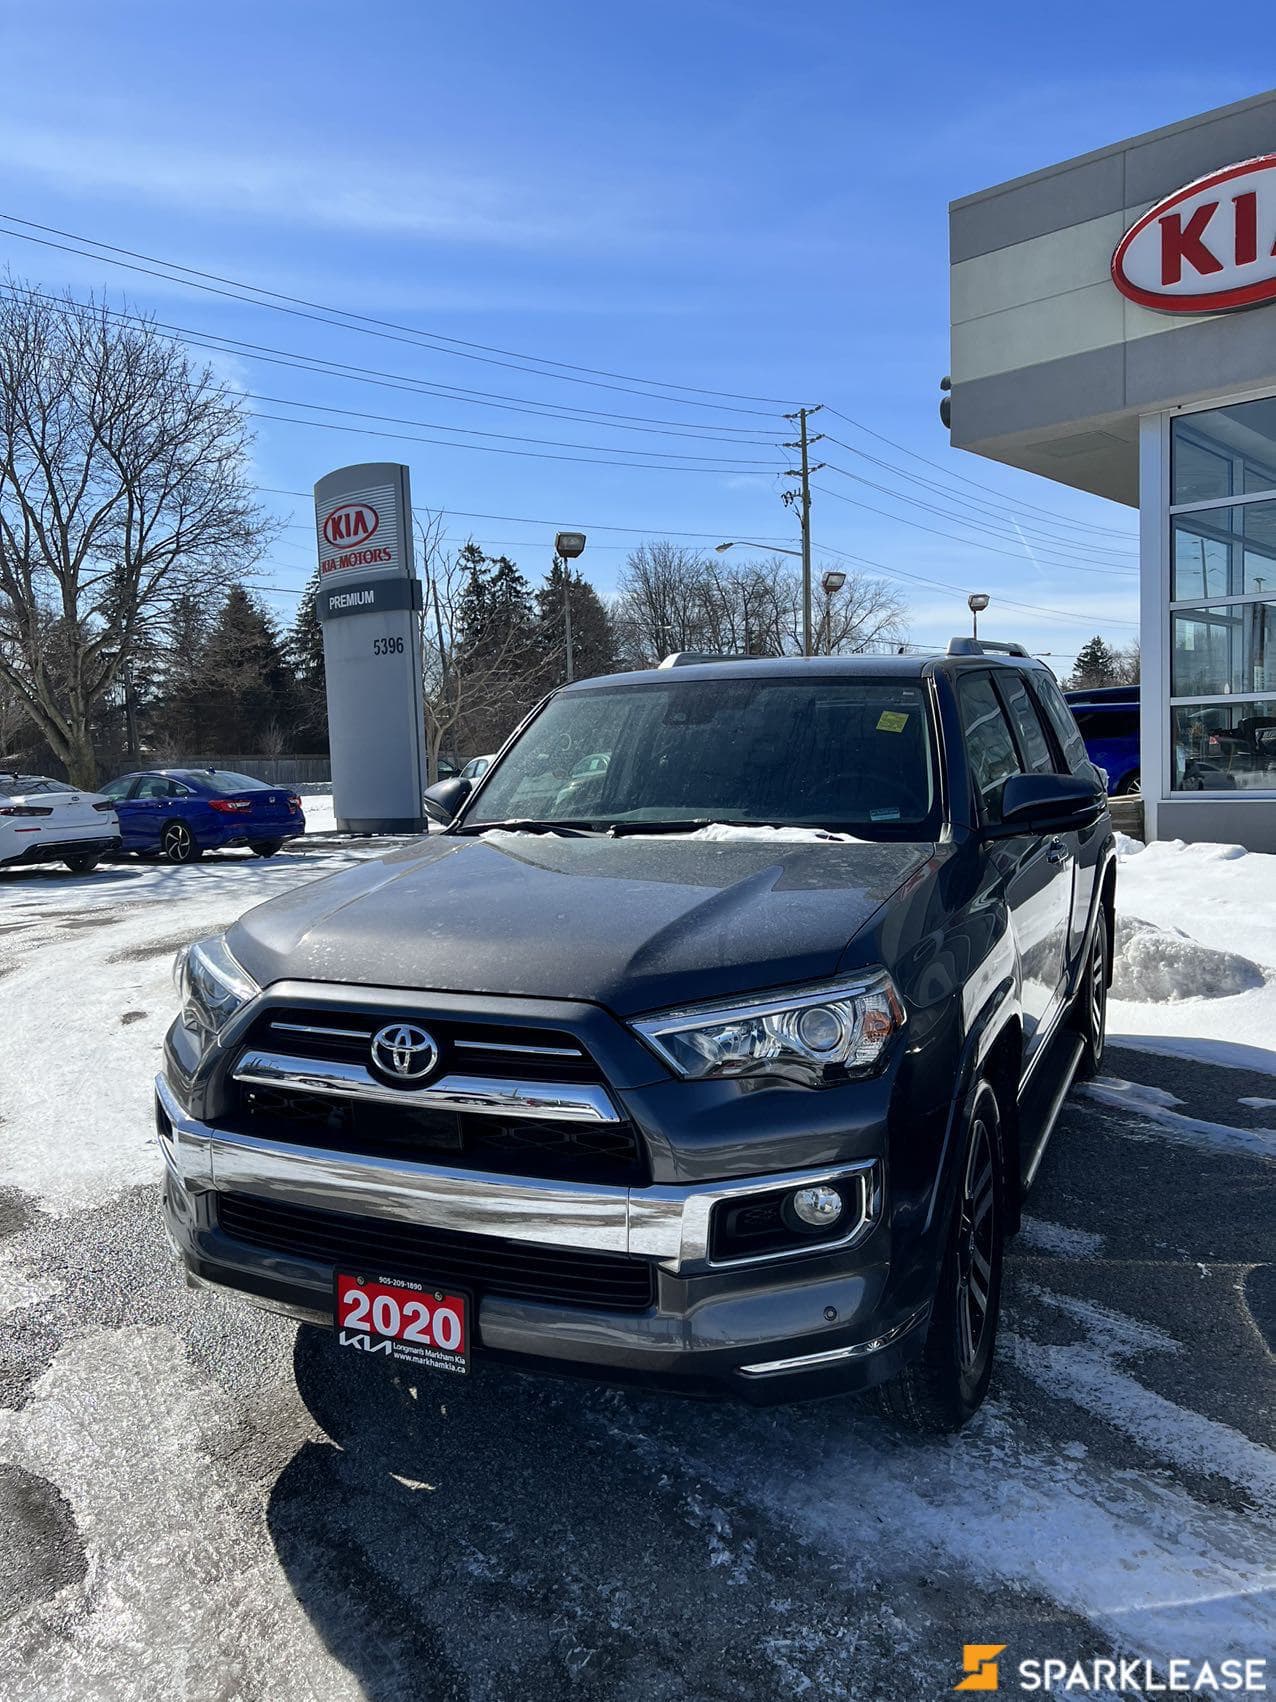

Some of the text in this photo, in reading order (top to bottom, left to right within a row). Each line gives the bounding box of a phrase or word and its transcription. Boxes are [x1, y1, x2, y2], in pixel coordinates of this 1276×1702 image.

[1158, 191, 1276, 286] KI
[331, 510, 369, 541] KIA
[322, 547, 392, 574] KIA MOTORS
[329, 590, 375, 610] PREMIUM
[373, 637, 404, 656] 5396
[378, 1276, 423, 1291] 905-209-1890
[343, 1289, 462, 1350] 2020
[393, 1352, 466, 1374] www.markhamkia.ca
[425, 1349, 454, 1362] Markham
[455, 1356, 466, 1365] Kia
